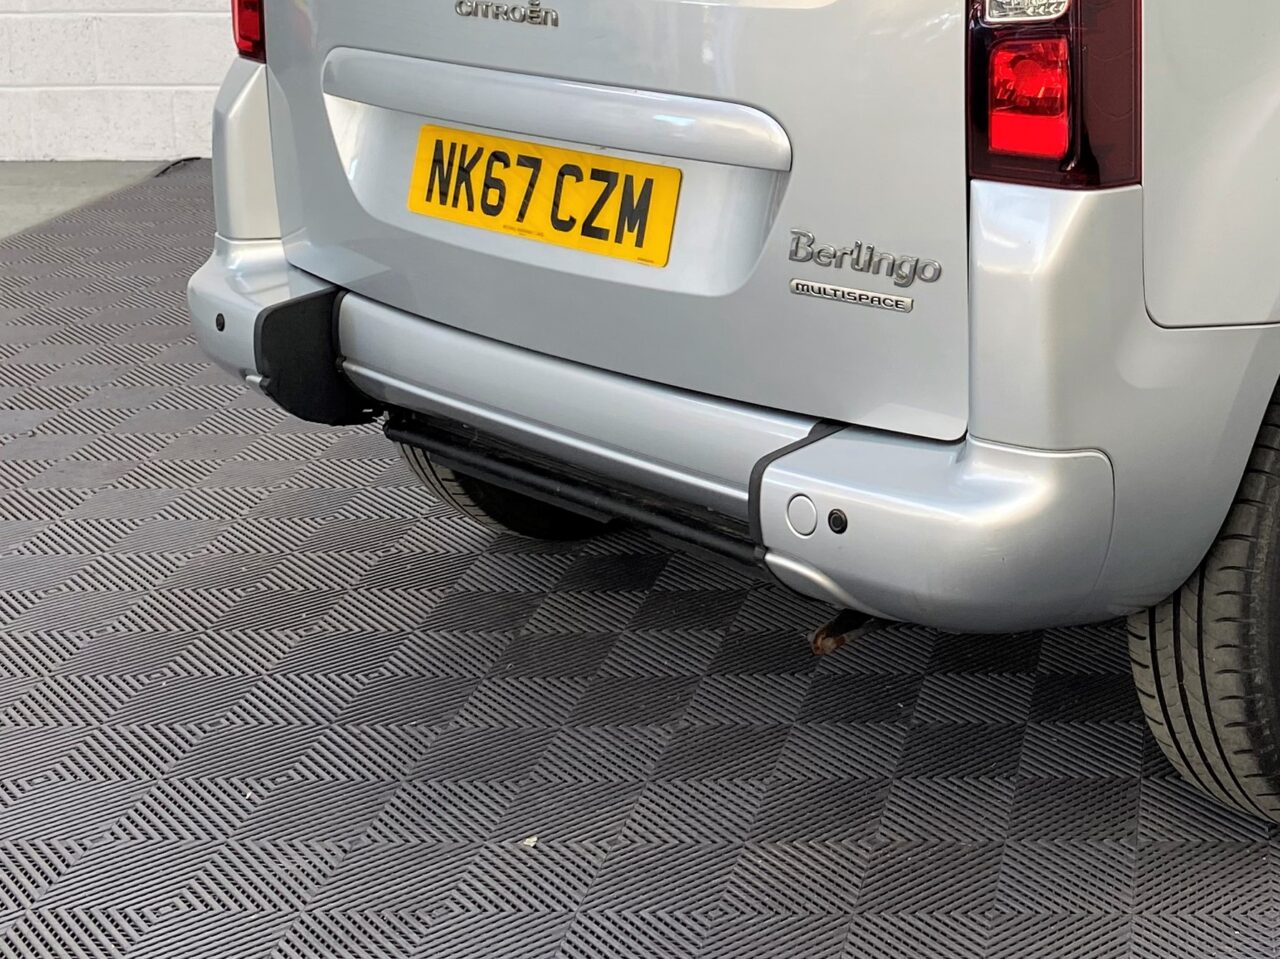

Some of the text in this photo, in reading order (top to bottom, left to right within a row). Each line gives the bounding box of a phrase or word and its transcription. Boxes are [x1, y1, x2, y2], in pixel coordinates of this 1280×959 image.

[424, 139, 654, 249] NK67 CZM
[788, 228, 942, 288] Berlingo
[795, 282, 906, 310] MULTISPACE
